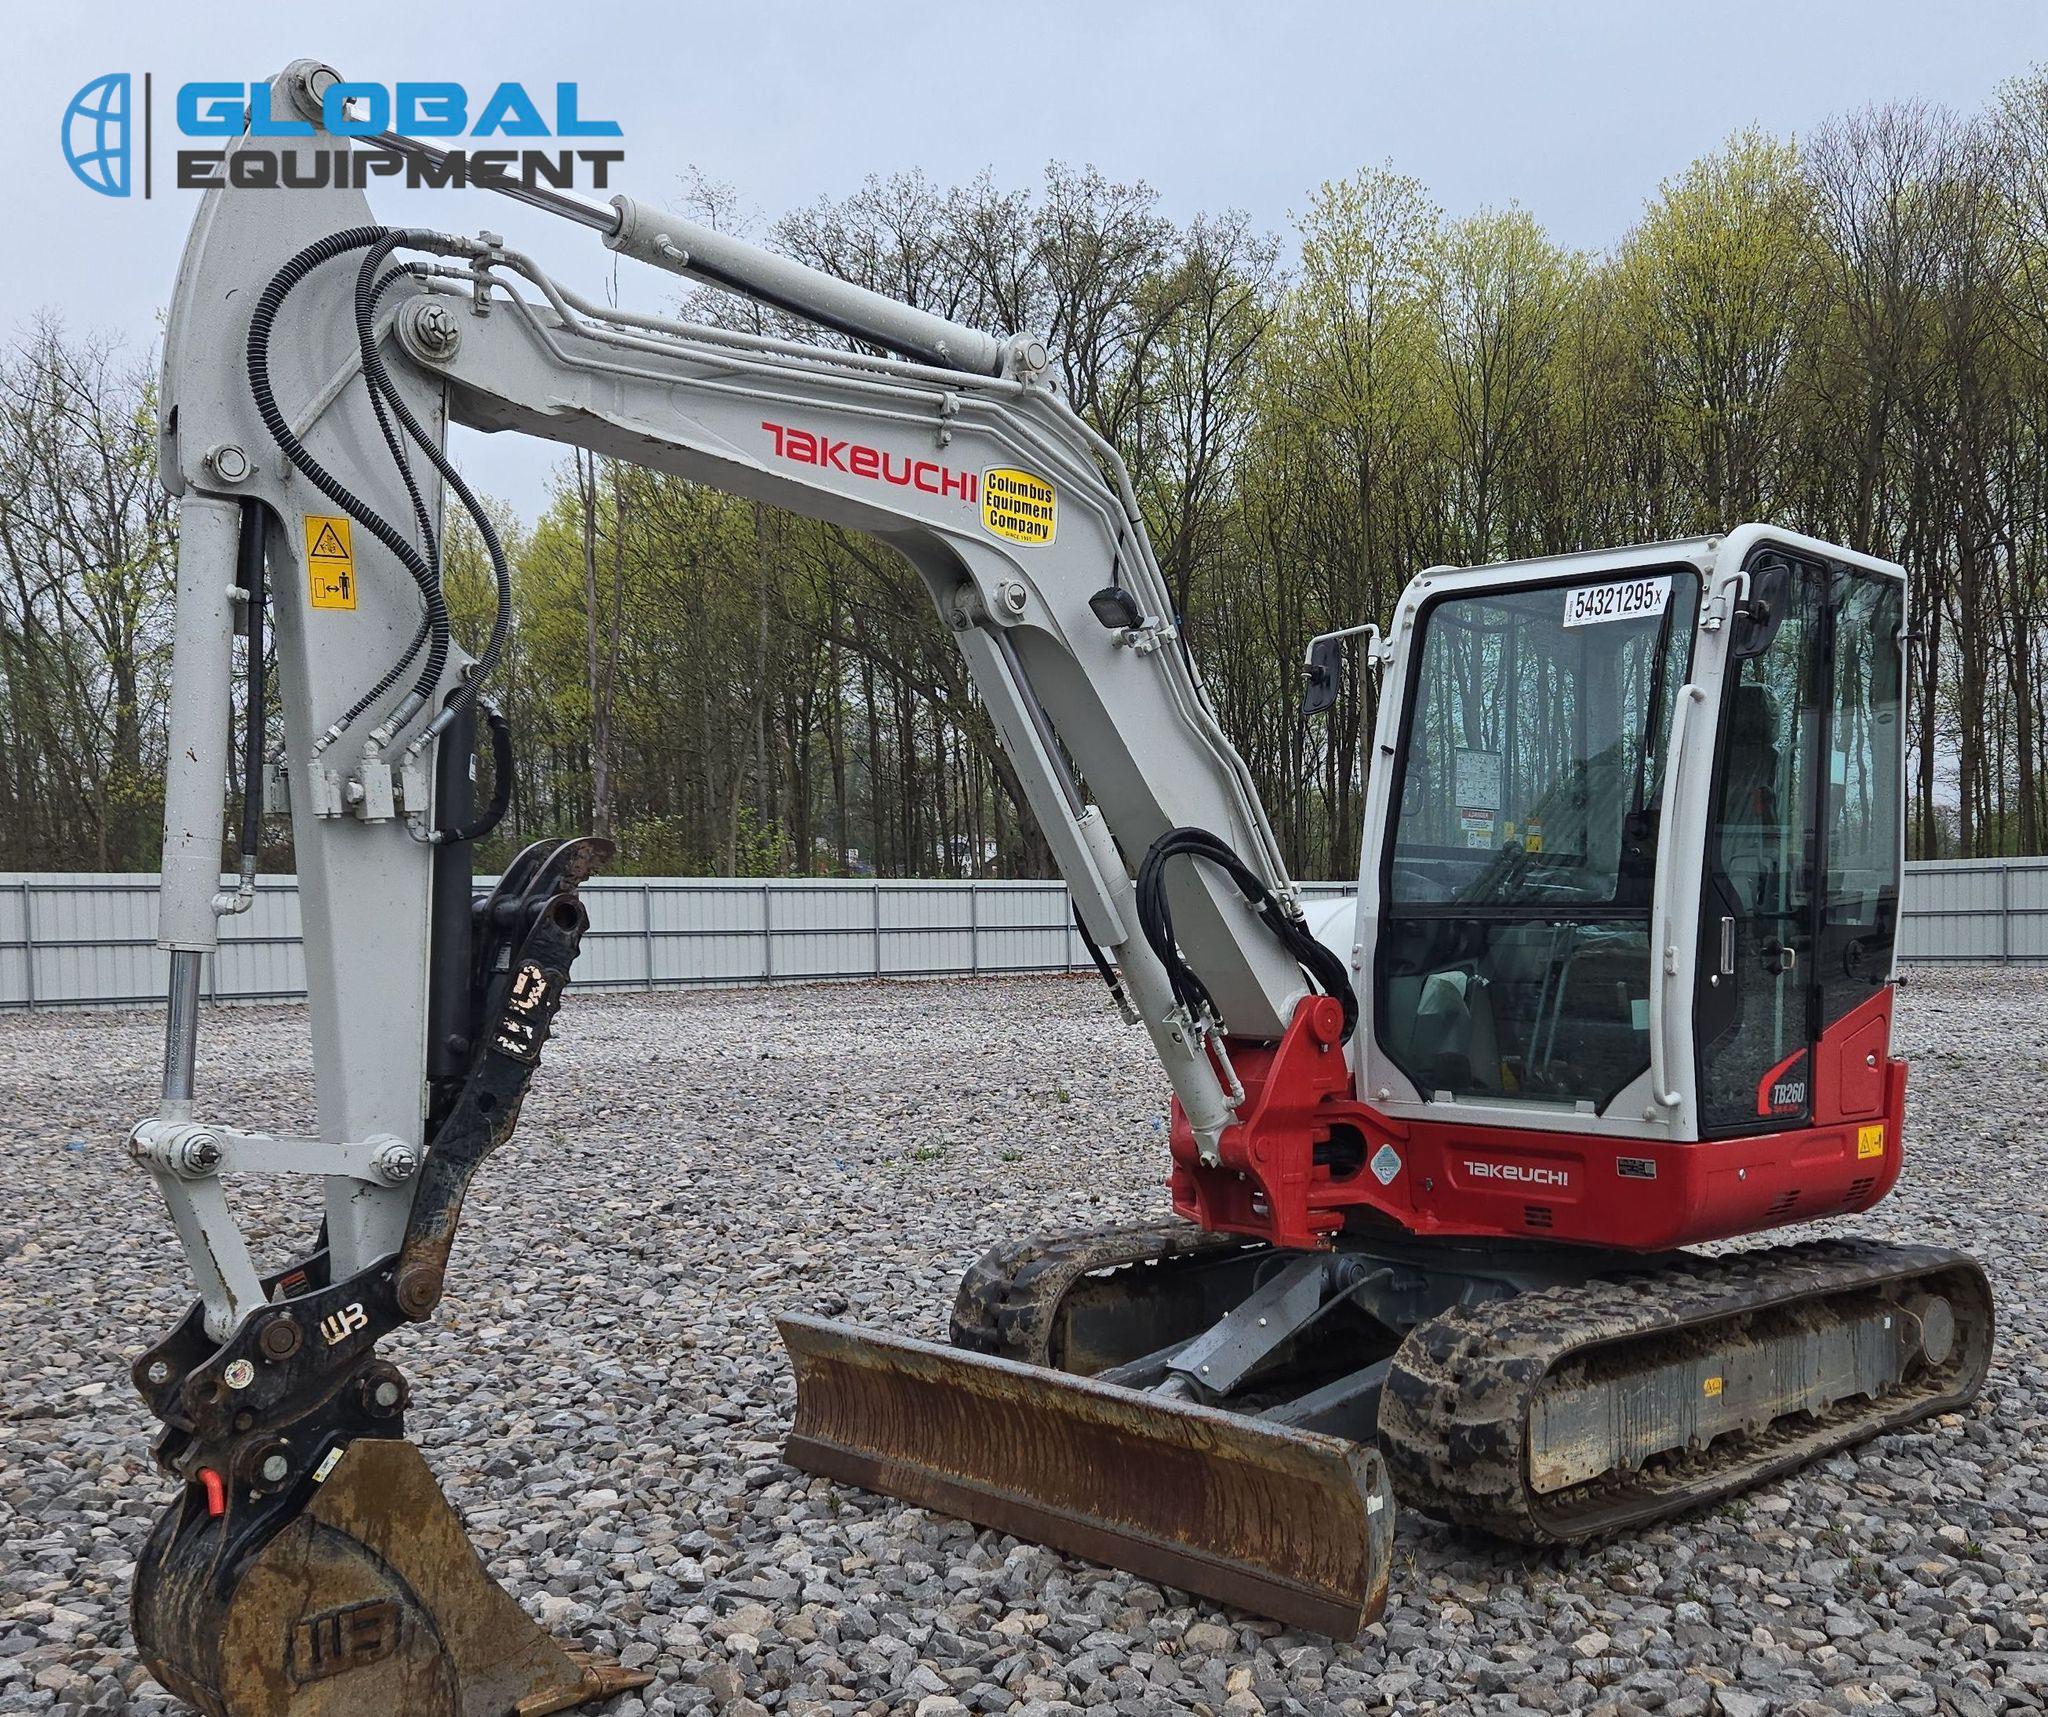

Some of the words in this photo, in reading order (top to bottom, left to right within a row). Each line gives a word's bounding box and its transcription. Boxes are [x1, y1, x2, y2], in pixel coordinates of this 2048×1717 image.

[988, 473, 1052, 503] Columbus
[986, 491, 1053, 521] Equipment
[990, 510, 1049, 539] Company
[1774, 1082, 1805, 1104] TB260
